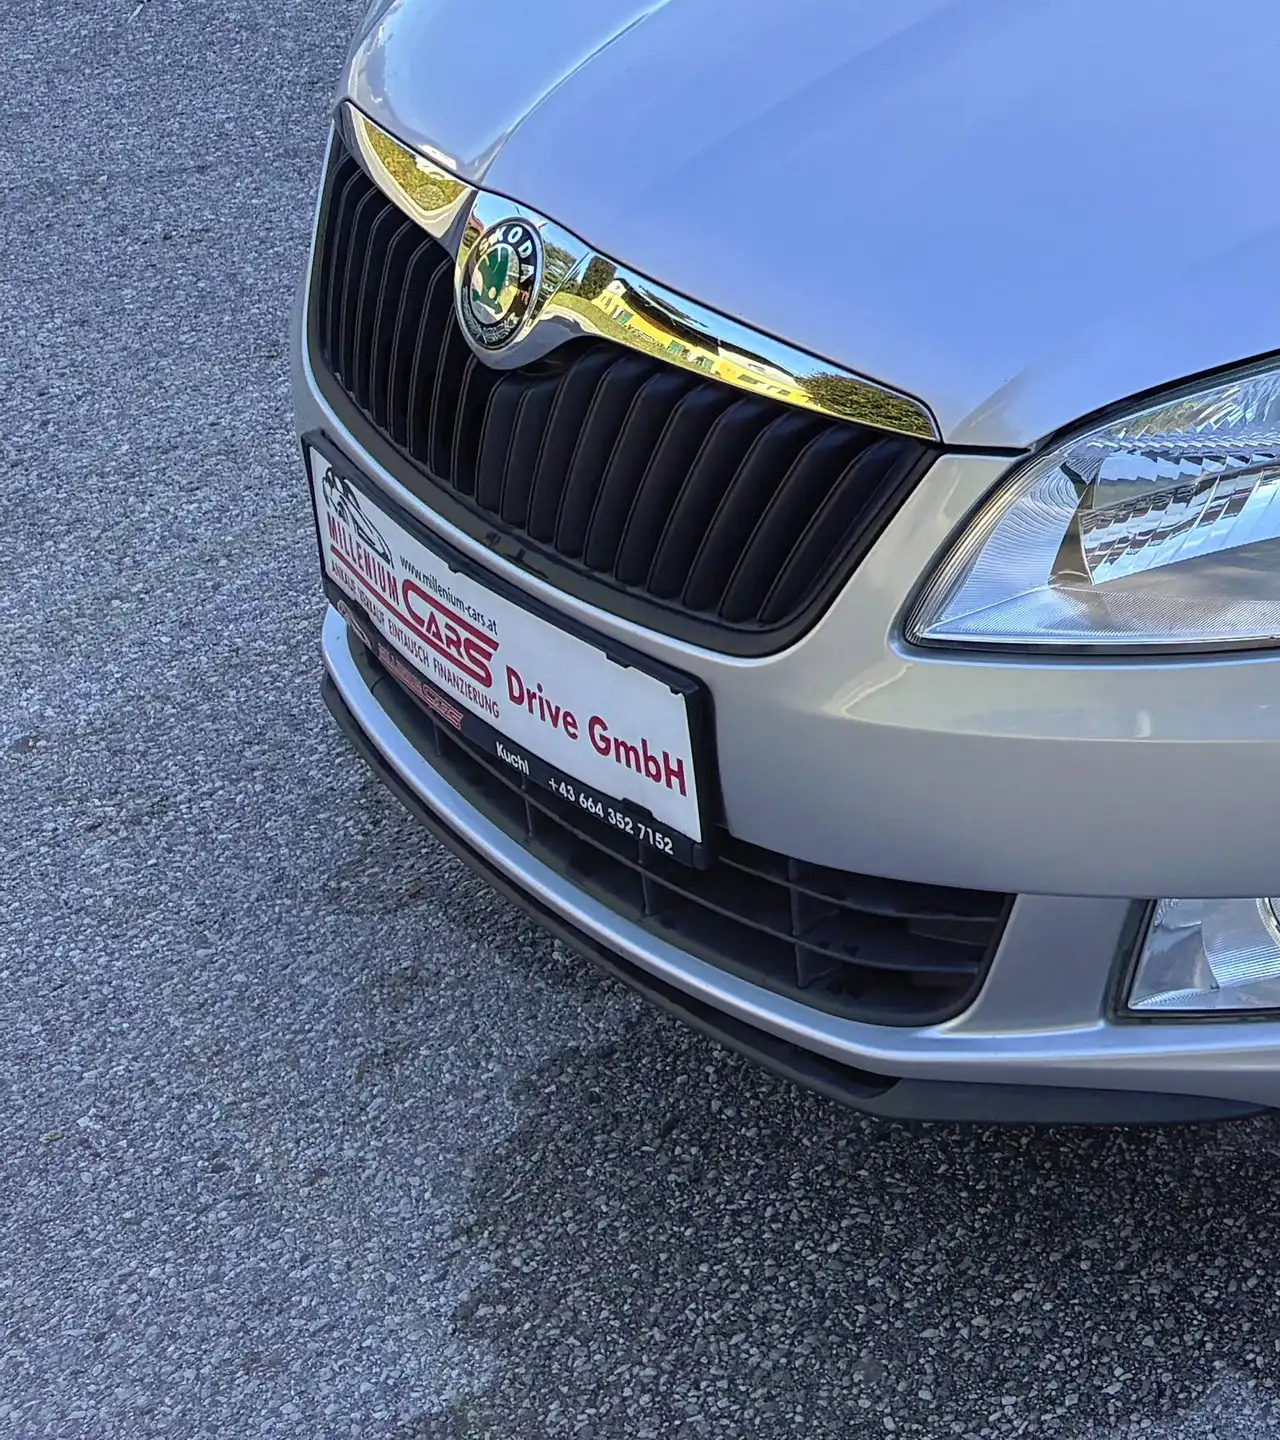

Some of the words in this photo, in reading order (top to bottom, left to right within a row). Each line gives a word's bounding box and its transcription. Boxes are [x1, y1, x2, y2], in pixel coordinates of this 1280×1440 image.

[400, 554, 499, 636] www.millenium-cars.at
[327, 511, 400, 607] MILLENIUM
[402, 578, 500, 689] CARS
[505, 664, 579, 741] Drive
[587, 714, 688, 798] GmbH
[388, 618, 430, 669] EINTAUSCH
[432, 656, 500, 720] FINANZIERUNG
[495, 741, 530, 776] Kuchl
[548, 777, 576, 802] +43
[579, 792, 605, 819] 664
[607, 807, 634, 835] 352
[637, 822, 674, 856] 7152
